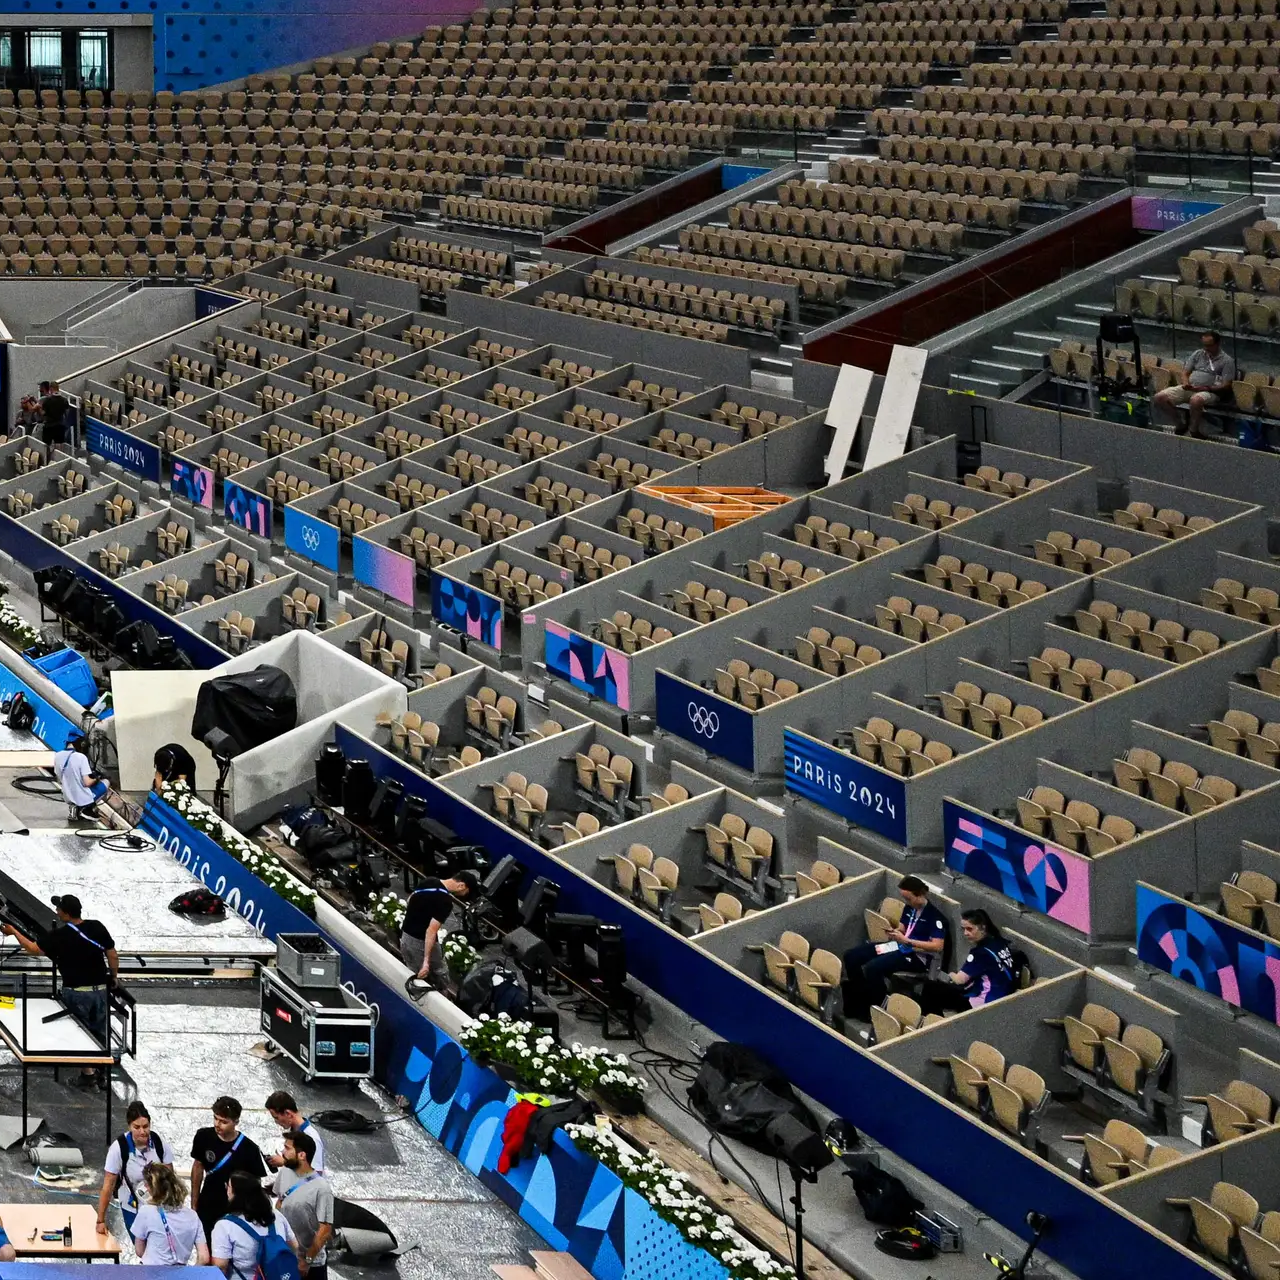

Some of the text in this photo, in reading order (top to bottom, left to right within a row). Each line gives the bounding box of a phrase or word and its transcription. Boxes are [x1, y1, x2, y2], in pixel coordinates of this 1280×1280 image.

[1157, 210, 1186, 221] PARIS
[99, 433, 145, 468] PARIS 2024
[794, 754, 896, 820] PARIS 2024
